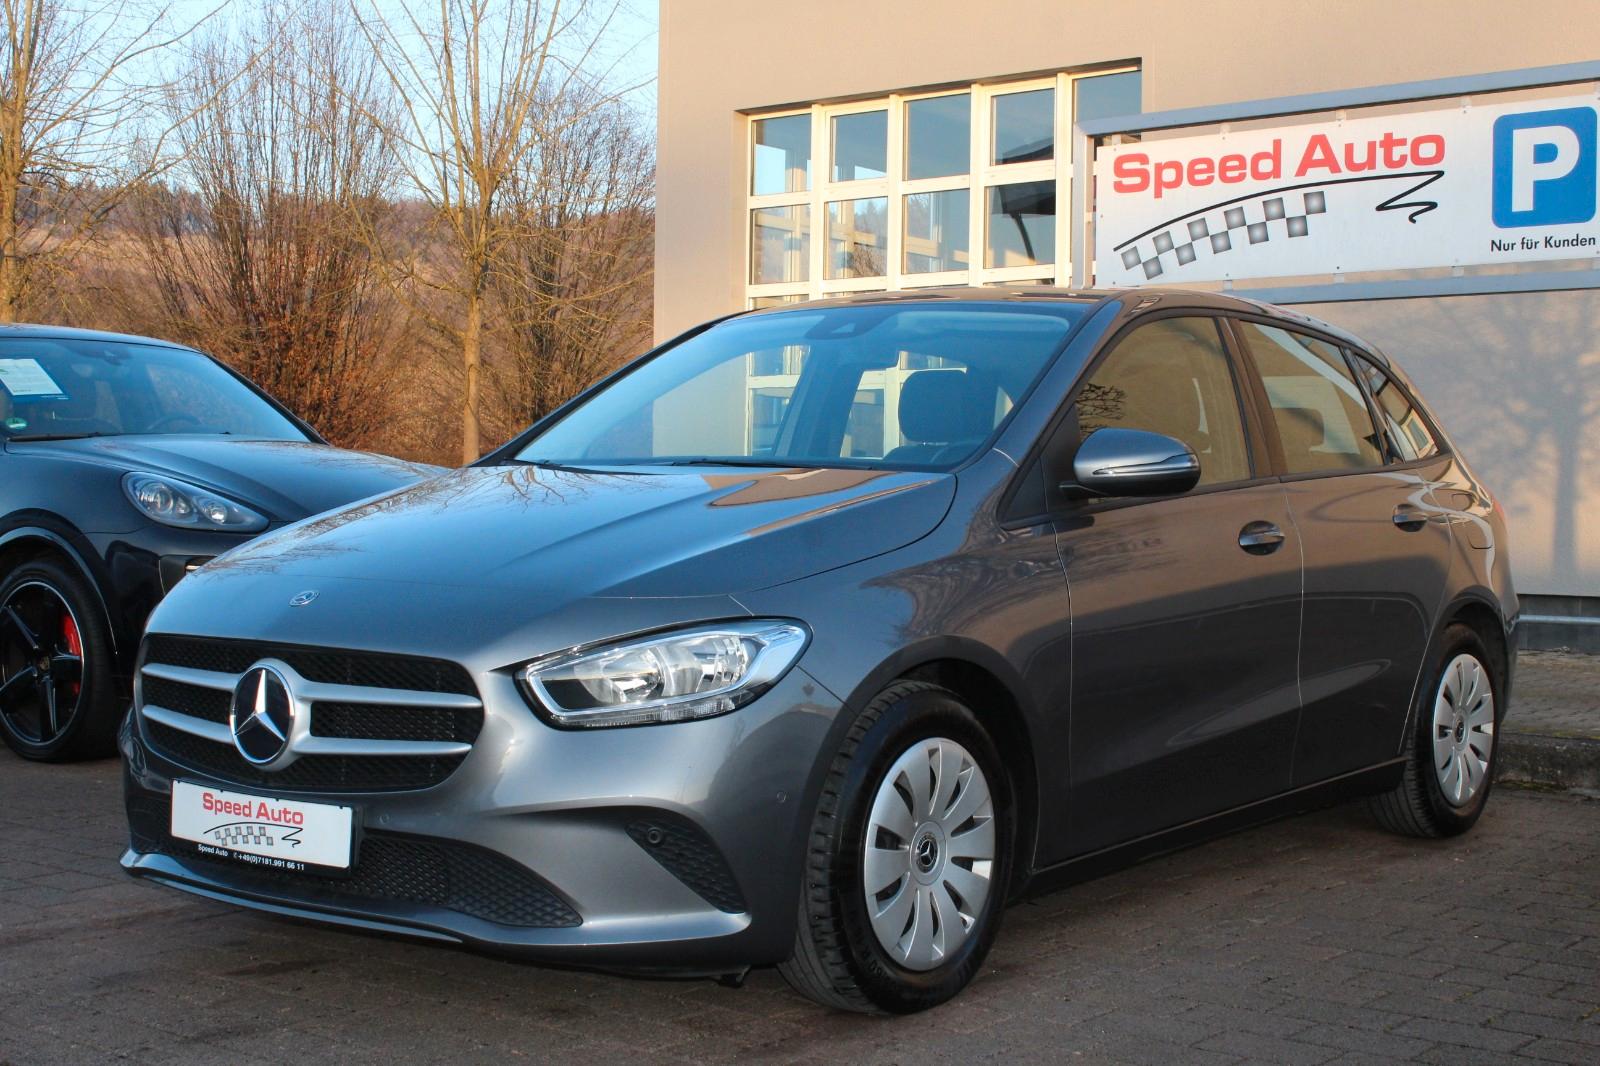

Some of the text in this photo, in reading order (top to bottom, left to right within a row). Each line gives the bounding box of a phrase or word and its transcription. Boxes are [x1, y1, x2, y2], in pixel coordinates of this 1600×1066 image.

[1113, 132, 1446, 198] Speed Auto
[1512, 125, 1580, 212] P
[1490, 233, 1596, 252] Nur für Kunden
[202, 792, 304, 825] Speed Auto
[198, 844, 215, 855] Speed
[215, 847, 229, 857] Auto
[297, 863, 305, 871] 11
